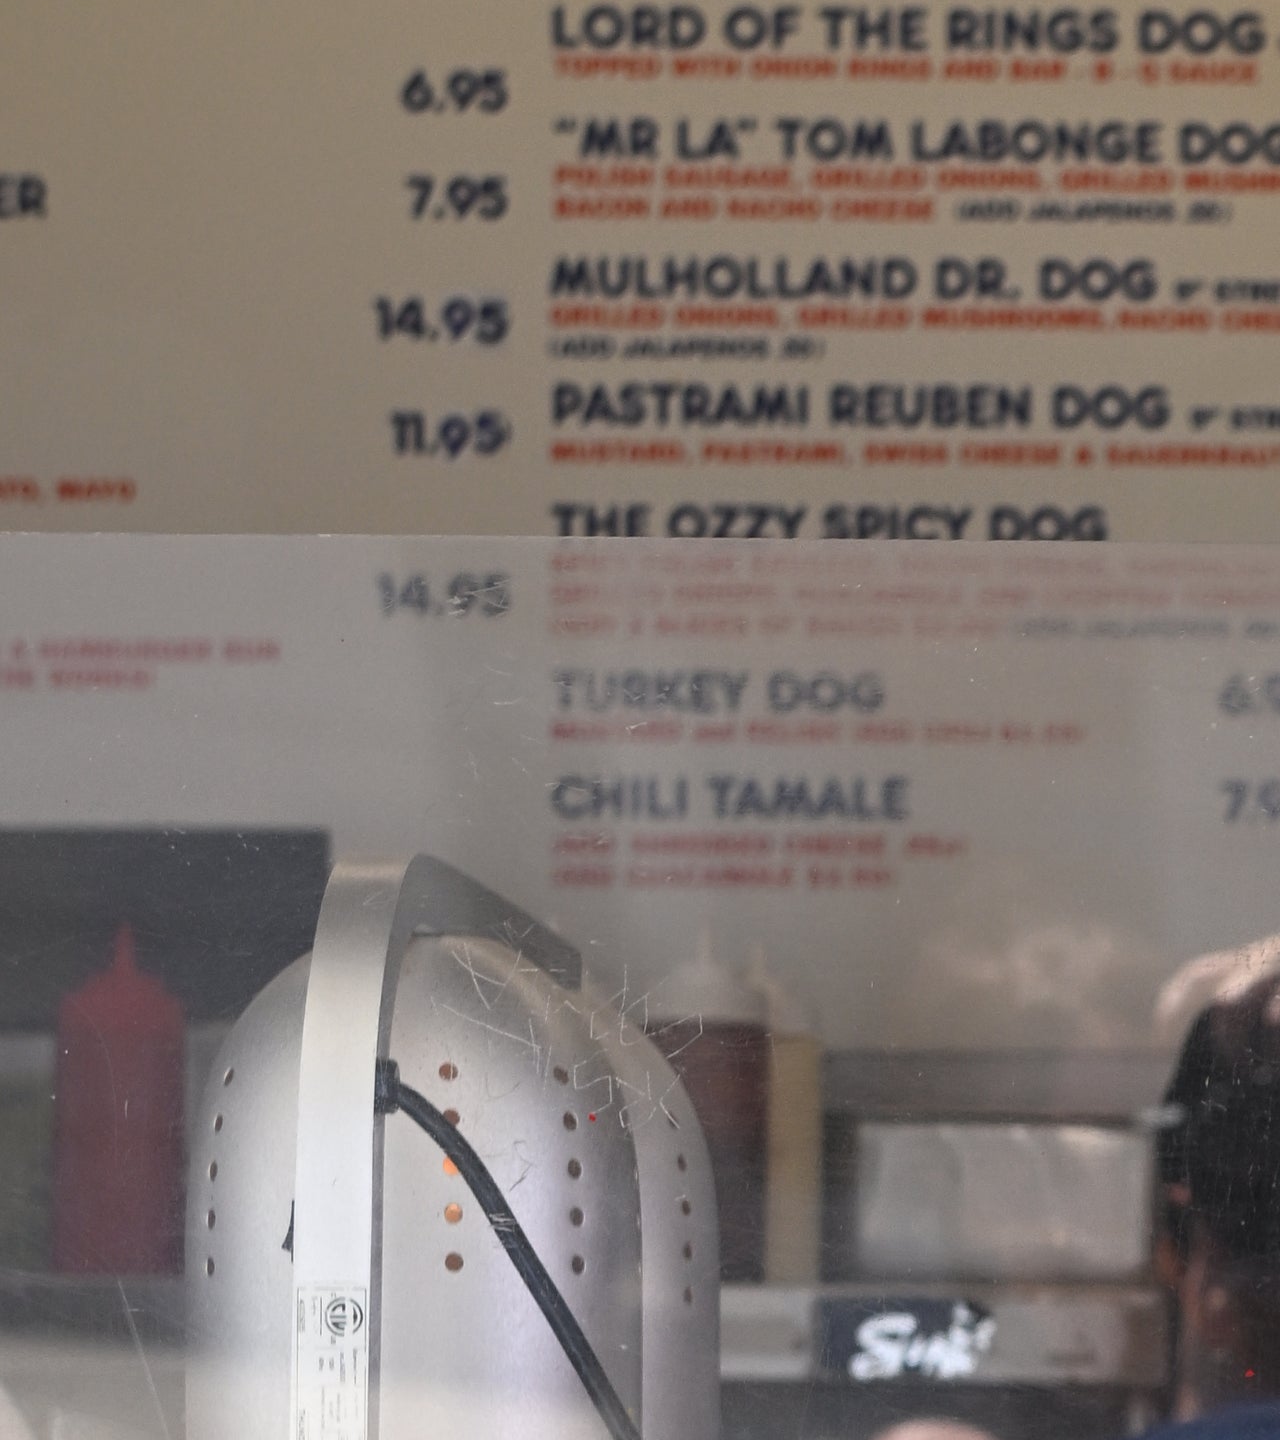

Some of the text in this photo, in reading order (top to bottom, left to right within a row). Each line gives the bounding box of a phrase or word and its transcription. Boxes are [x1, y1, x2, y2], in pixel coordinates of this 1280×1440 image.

[550, 4, 1267, 57] LORD OF THE RINGS DOG
[401, 70, 508, 113] 6.95
[776, 118, 893, 162] TOM
[911, 120, 1160, 164] LABONGE
[408, 176, 507, 220] 7.95
[549, 256, 1157, 302] MULHOLLAND DR. DOG
[375, 298, 509, 346] 14.95
[552, 382, 1170, 429] PASTRAMI REUBEN DOG
[390, 411, 510, 458] 11.95
[767, 671, 885, 715] DOG
[550, 776, 909, 822] CHILI TAMALE
